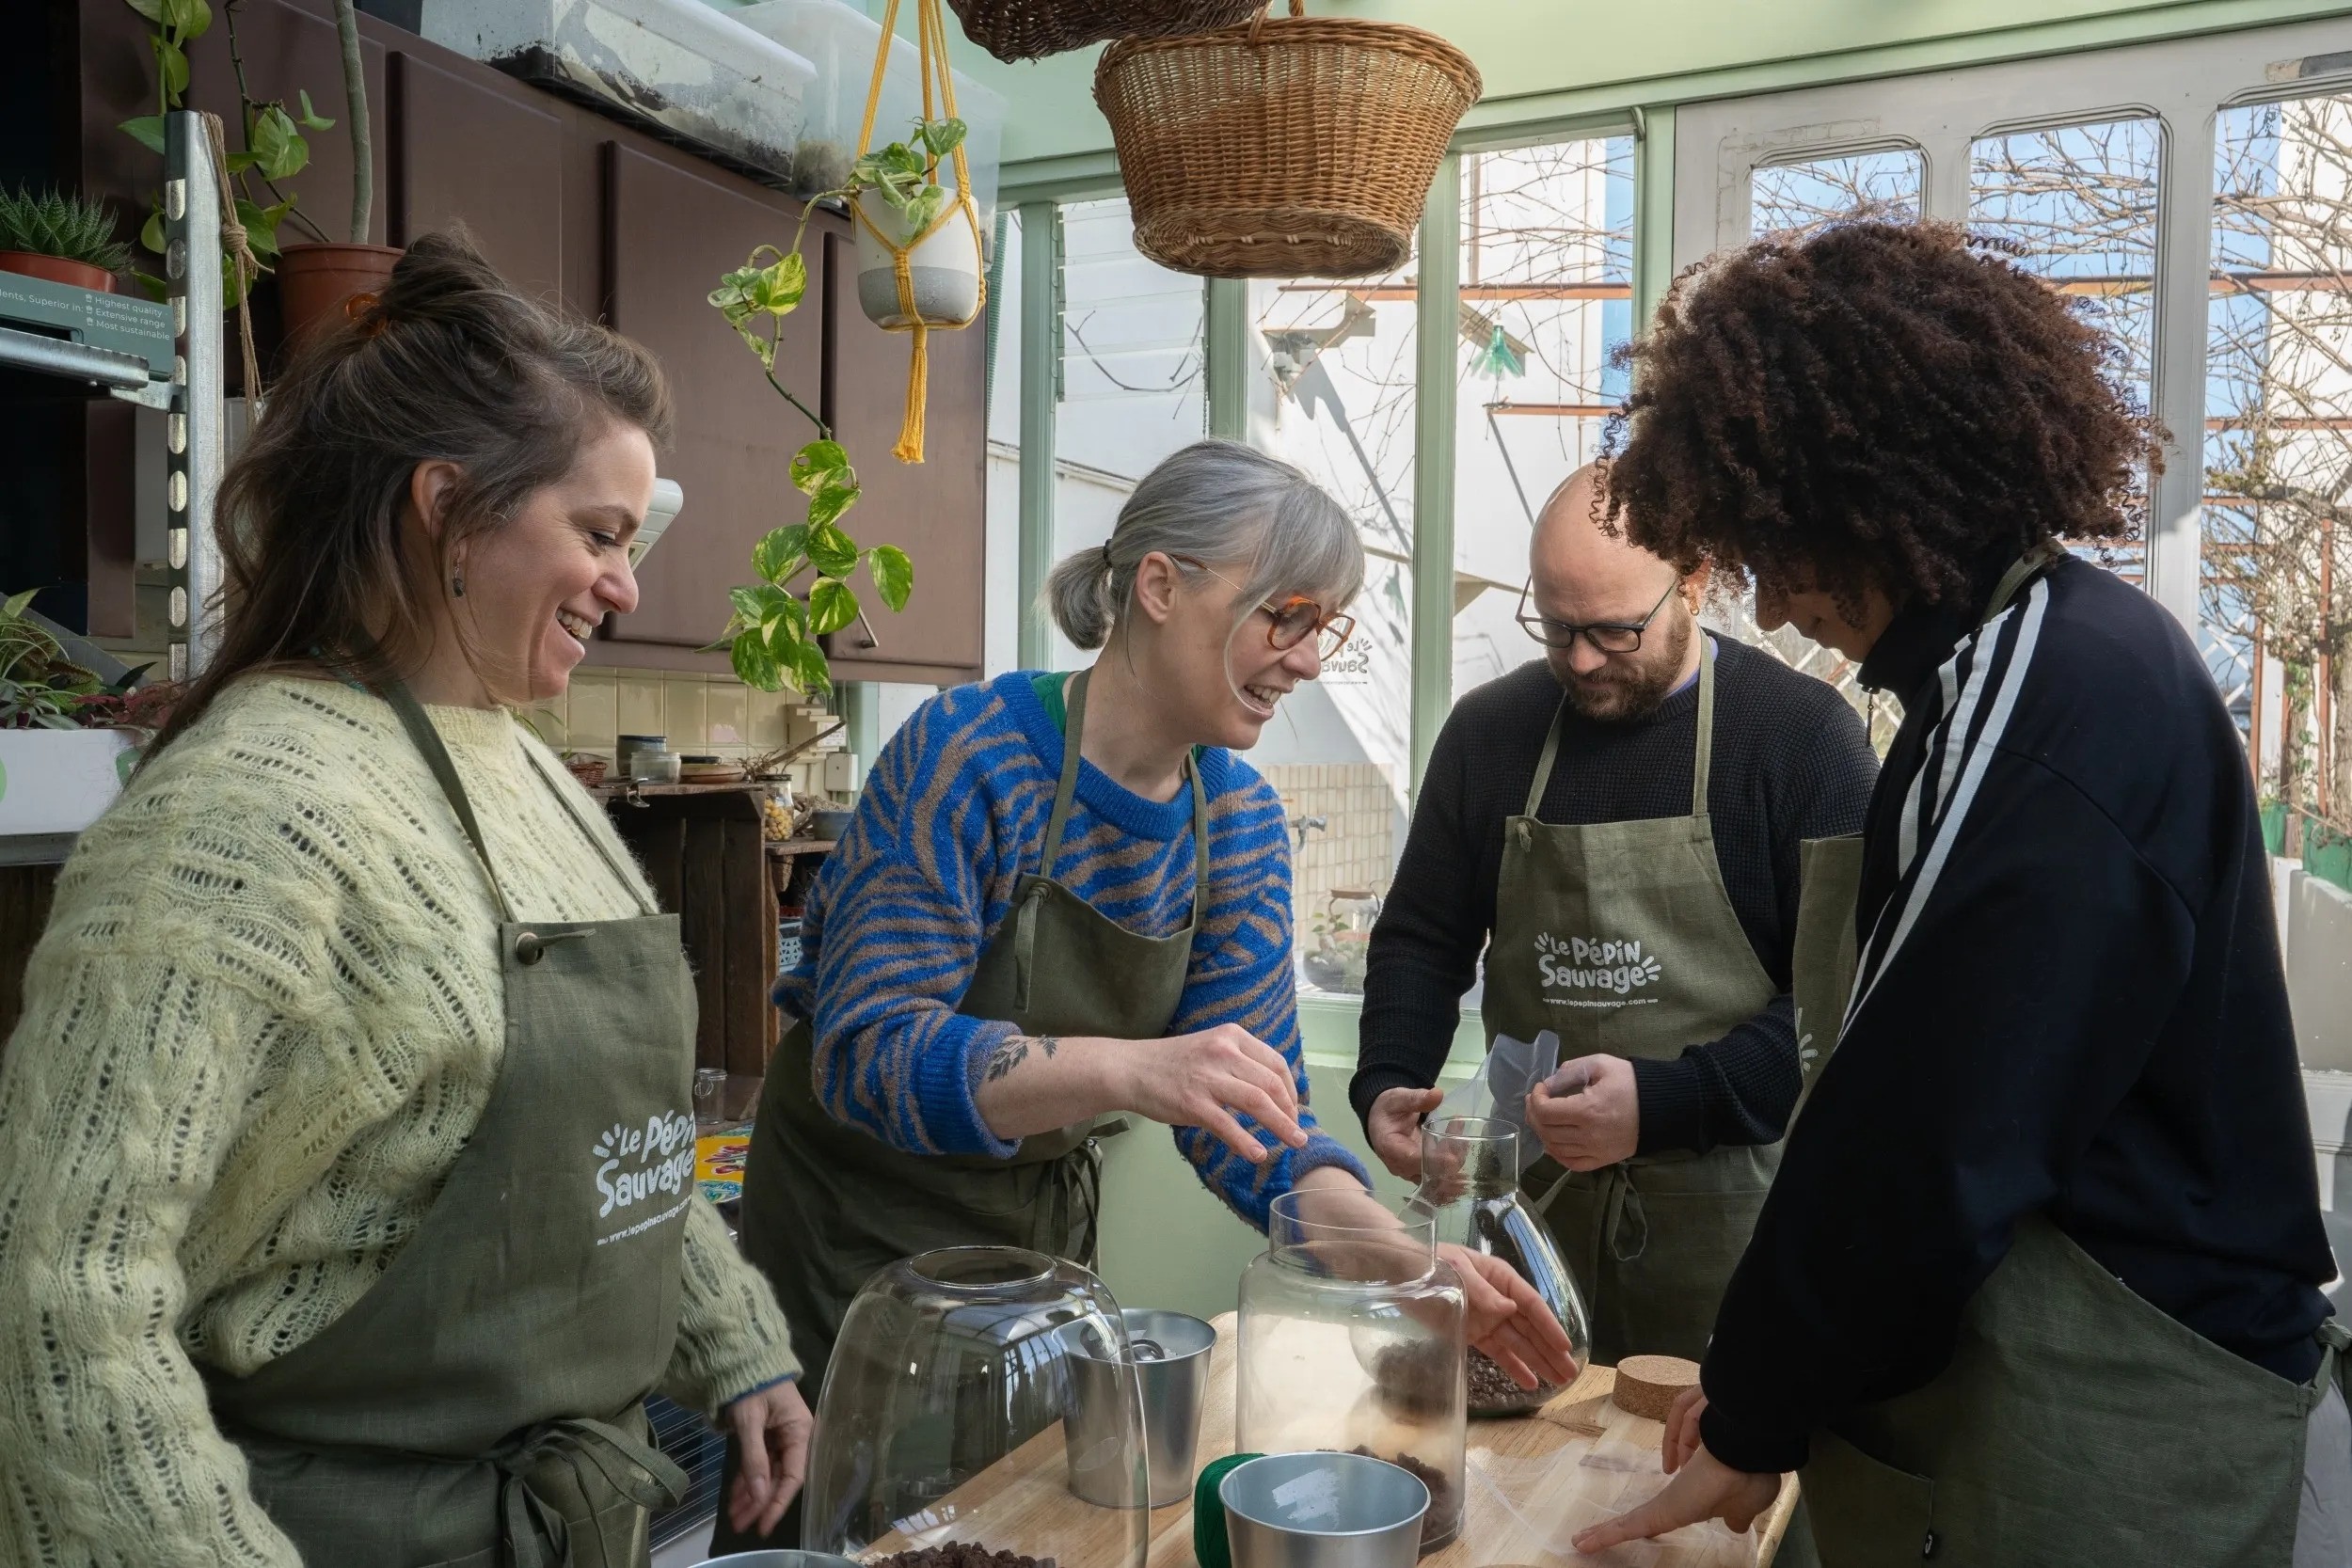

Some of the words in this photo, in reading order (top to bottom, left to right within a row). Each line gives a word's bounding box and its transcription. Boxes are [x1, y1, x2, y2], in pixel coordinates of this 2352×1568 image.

[28, 294, 70, 310] Superior
[72, 304, 84, 313] in:
[95, 296, 130, 310] Highest
[132, 305, 163, 318] quality
[95, 308, 138, 323] Extensive
[140, 318, 166, 329] range
[96, 320, 119, 330] Most
[119, 325, 170, 341] sustainable
[1549, 936, 1570, 956] Le
[1538, 954, 1647, 994] Sauvage
[1549, 997, 1646, 1008] www.lepepinsauvage.com
[619, 1127, 642, 1157] Le
[596, 1147, 695, 1219] Sauvage
